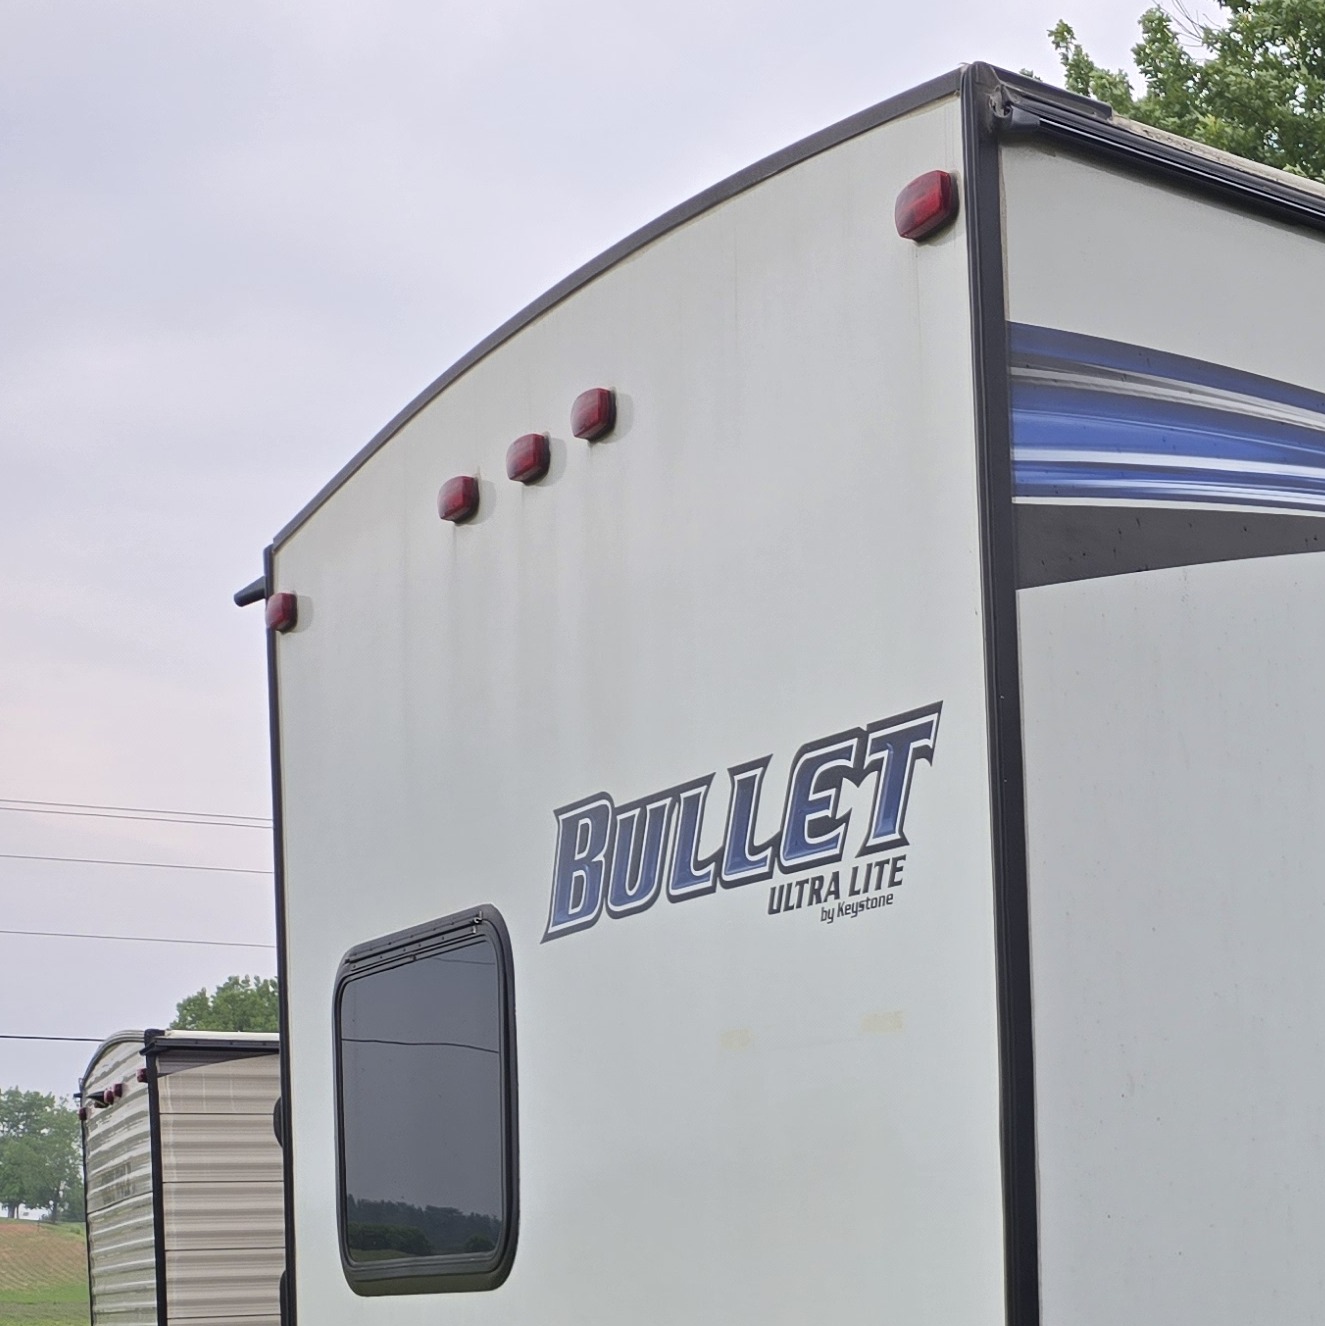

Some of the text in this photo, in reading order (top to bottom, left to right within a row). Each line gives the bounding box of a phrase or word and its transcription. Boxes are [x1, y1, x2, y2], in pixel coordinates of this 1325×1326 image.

[540, 700, 943, 944] BULLET
[768, 854, 906, 915] ULTRA LITE
[820, 893, 894, 924] by Keystone
